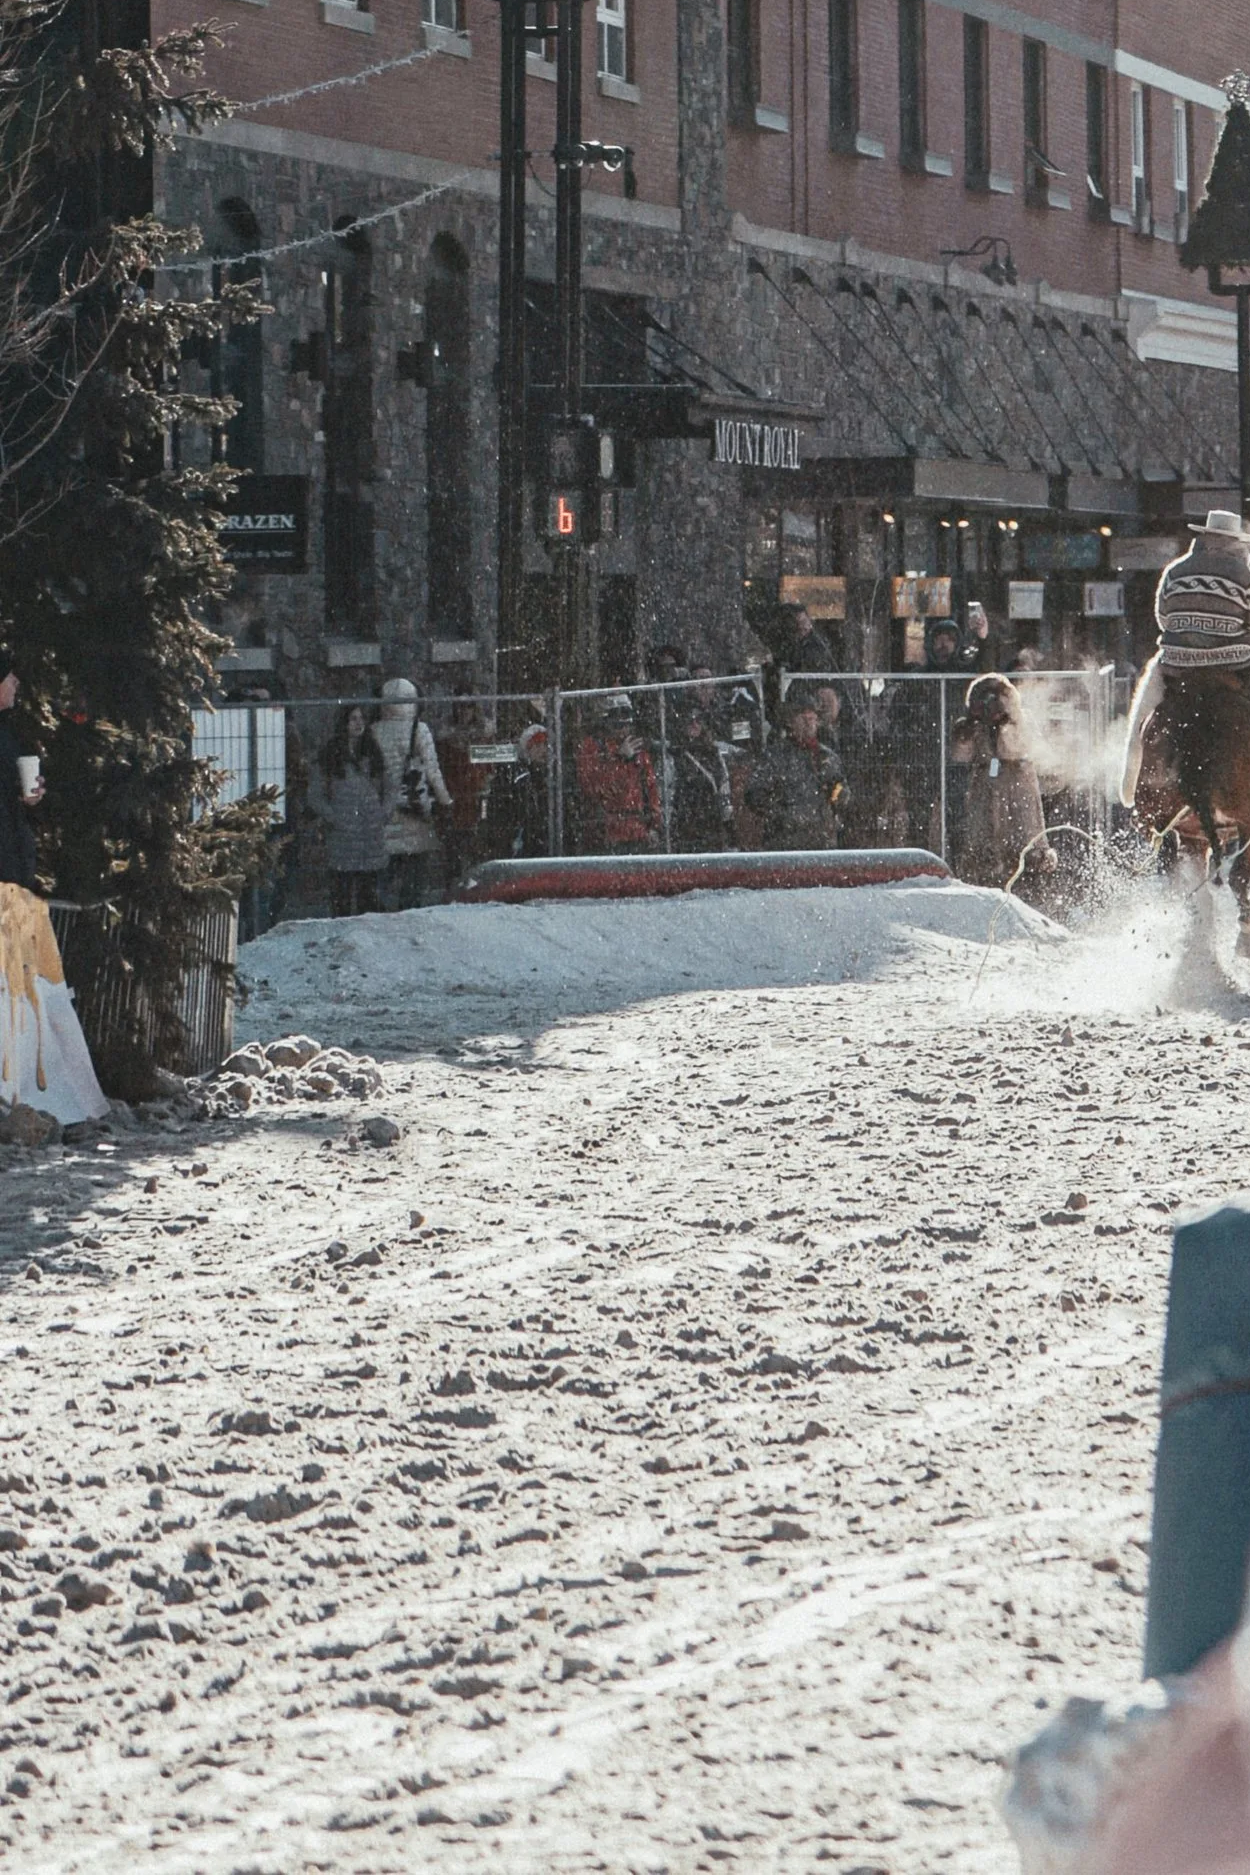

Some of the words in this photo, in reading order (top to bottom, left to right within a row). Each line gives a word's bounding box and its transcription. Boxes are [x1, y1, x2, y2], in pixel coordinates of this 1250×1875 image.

[715, 419, 761, 465] MOUNT
[764, 425, 801, 469] ROYAL
[226, 513, 296, 530] RAZEN
